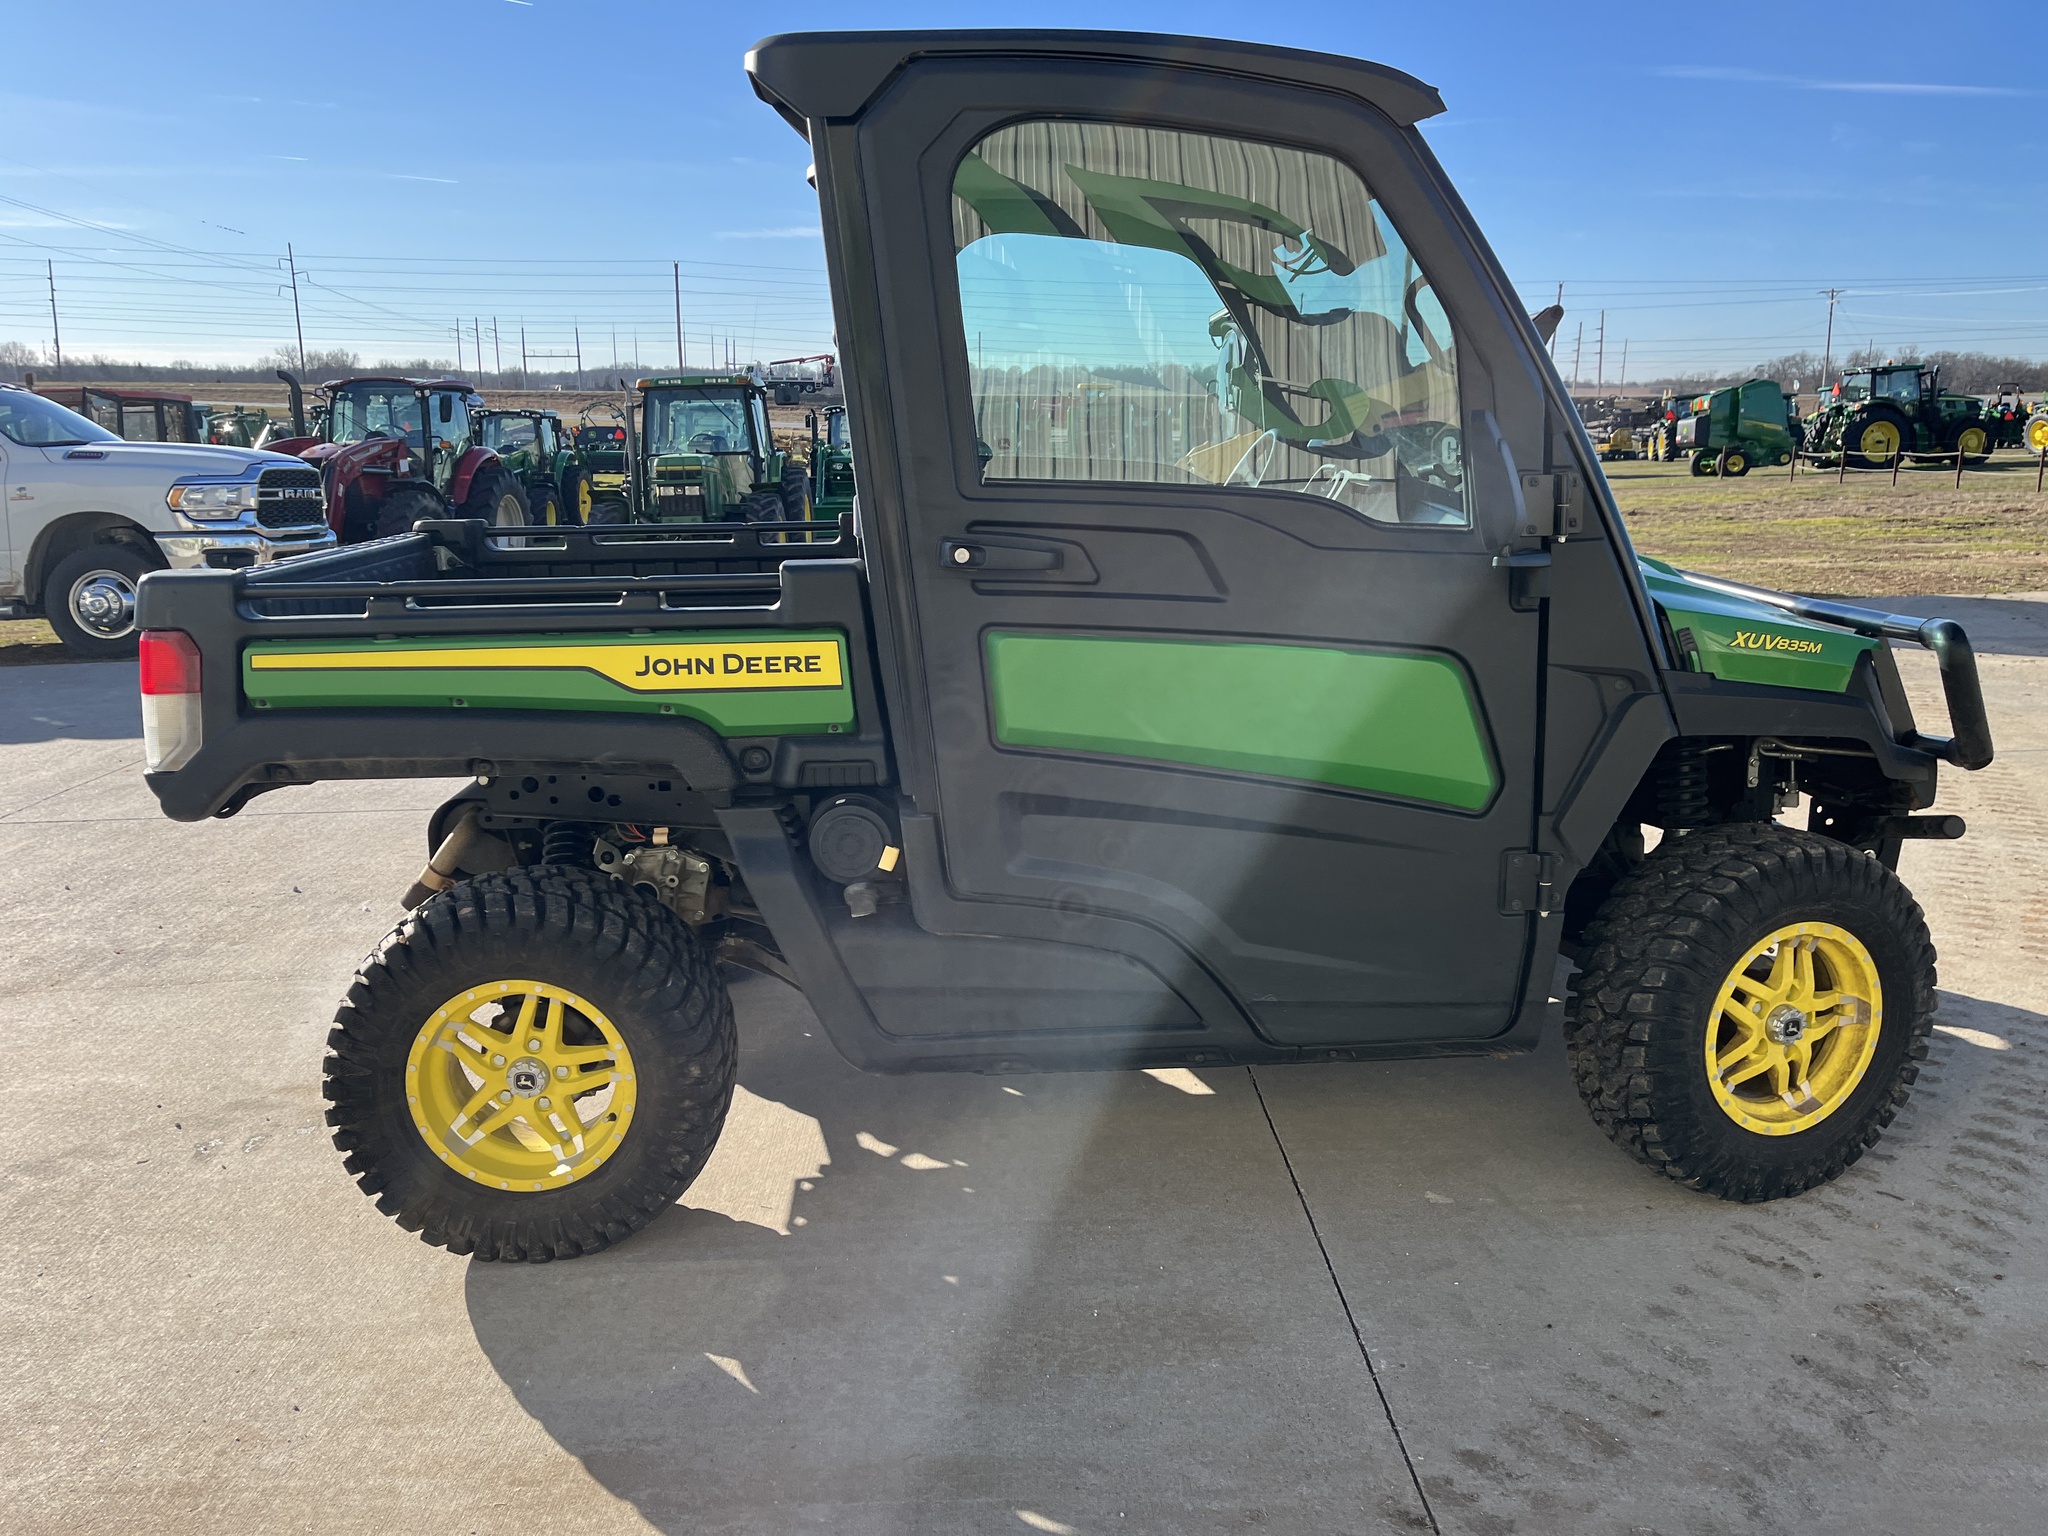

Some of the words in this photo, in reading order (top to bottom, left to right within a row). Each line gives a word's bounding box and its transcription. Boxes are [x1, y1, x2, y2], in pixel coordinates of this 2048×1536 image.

[284, 489, 315, 499] RAM
[1729, 631, 1823, 654] XUV835M
[635, 655, 715, 677] JOHN
[723, 653, 822, 674] DEERE
